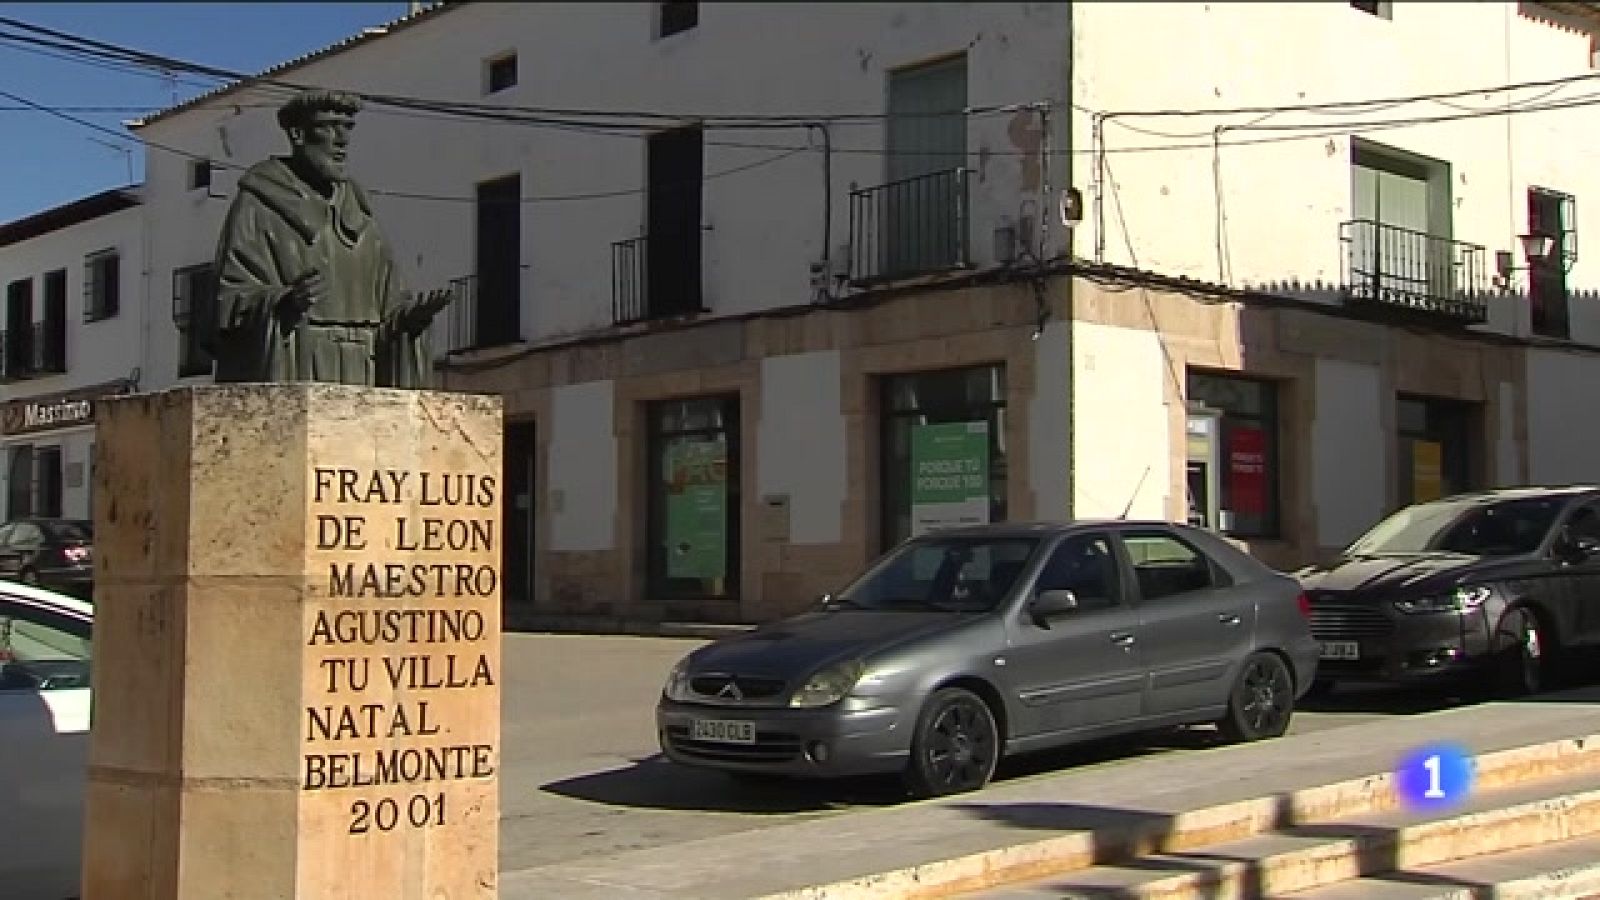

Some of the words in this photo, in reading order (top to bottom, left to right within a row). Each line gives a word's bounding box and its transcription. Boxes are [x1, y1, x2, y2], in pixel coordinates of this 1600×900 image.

[313, 467, 411, 503] FRAY
[419, 472, 497, 507] LUIS
[316, 514, 368, 551] DE
[395, 517, 495, 552] LEON
[329, 562, 497, 599] MAESTRO
[320, 657, 371, 693] TU
[381, 654, 496, 690] VILLA
[303, 744, 495, 791] BELMONTE
[348, 792, 446, 834] 2001
